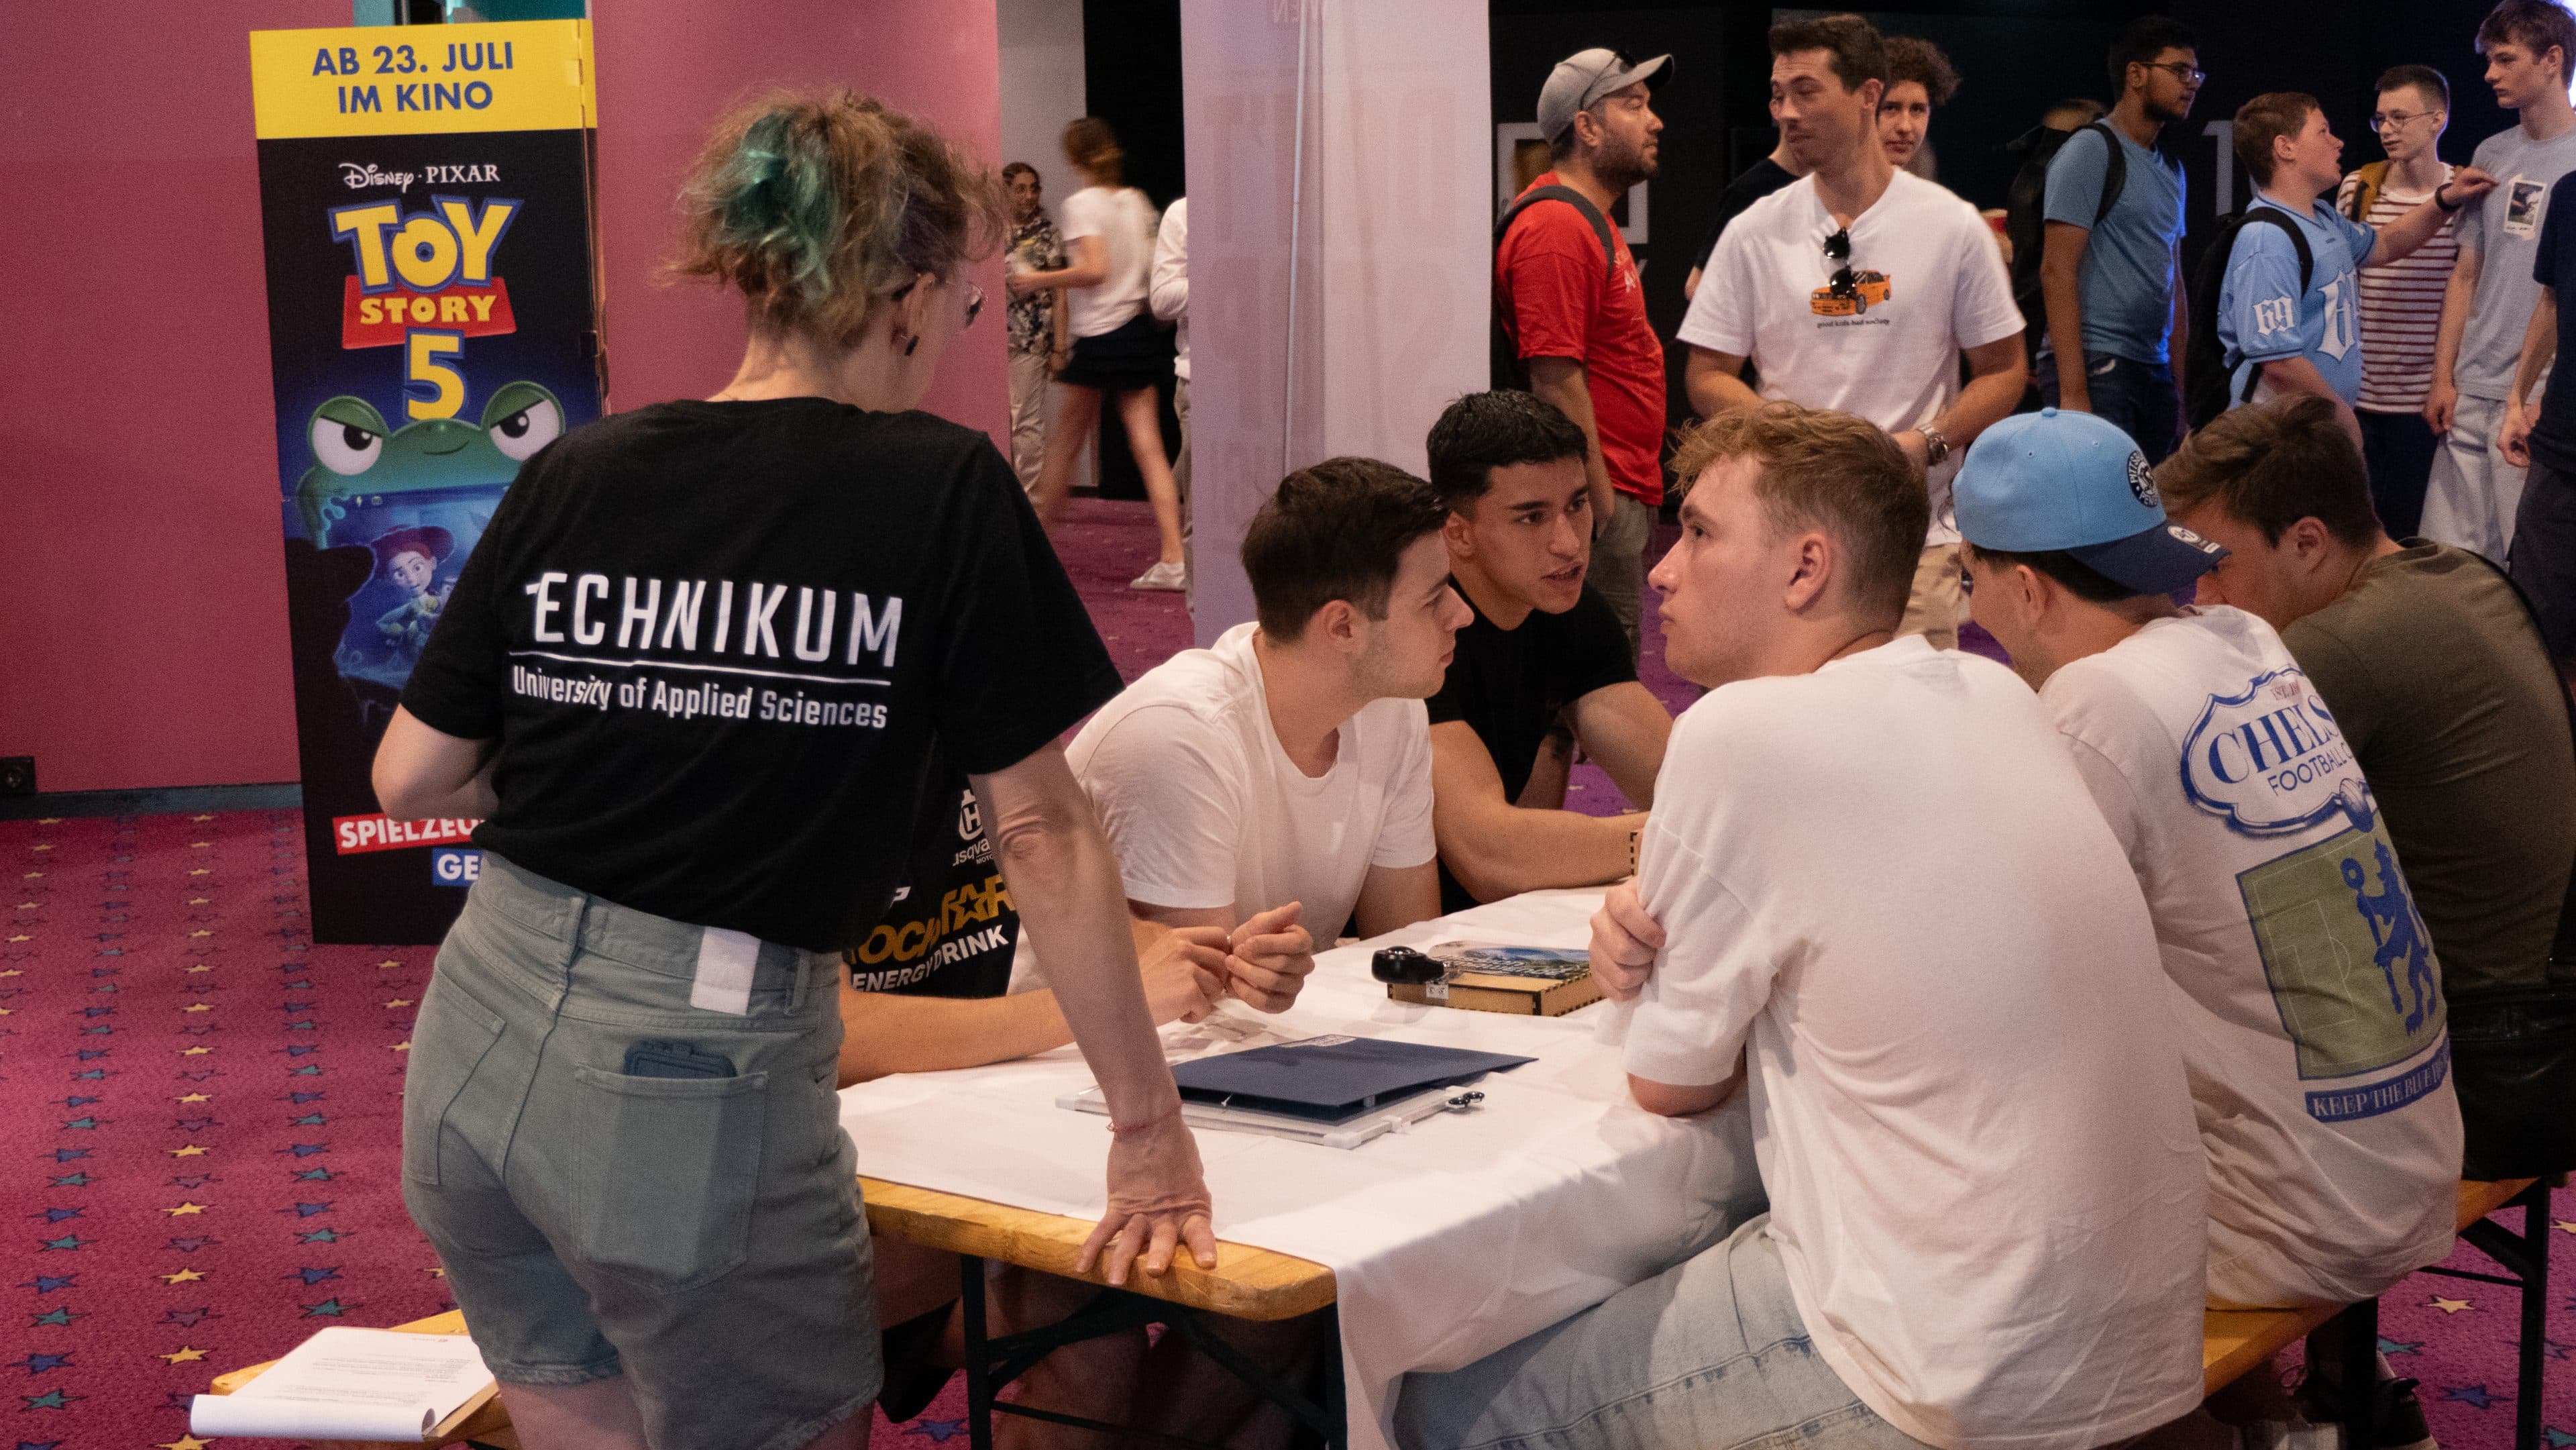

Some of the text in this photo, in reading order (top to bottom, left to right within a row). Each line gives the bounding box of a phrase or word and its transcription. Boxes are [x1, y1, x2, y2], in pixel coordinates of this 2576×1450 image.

[313, 42, 513, 76] AB 23. JULI
[338, 81, 493, 113] IM KINO
[426, 164, 500, 183] PIXAR
[329, 196, 521, 294] TOY
[360, 295, 497, 325] STORY
[2253, 296, 2295, 336] 69
[404, 329, 464, 420] 5
[513, 665, 888, 729] University of Applied Sciences
[2208, 695, 2340, 784] CHELS
[2267, 741, 2353, 796] FOOTBALL C
[339, 818, 486, 848] SPIELZEU
[437, 853, 479, 881] GE
[976, 853, 994, 864] MOTO
[853, 925, 1008, 992] ENERGY DRINK
[2314, 1092, 2367, 1117] KEEP
[2371, 1082, 2404, 1109] THE
